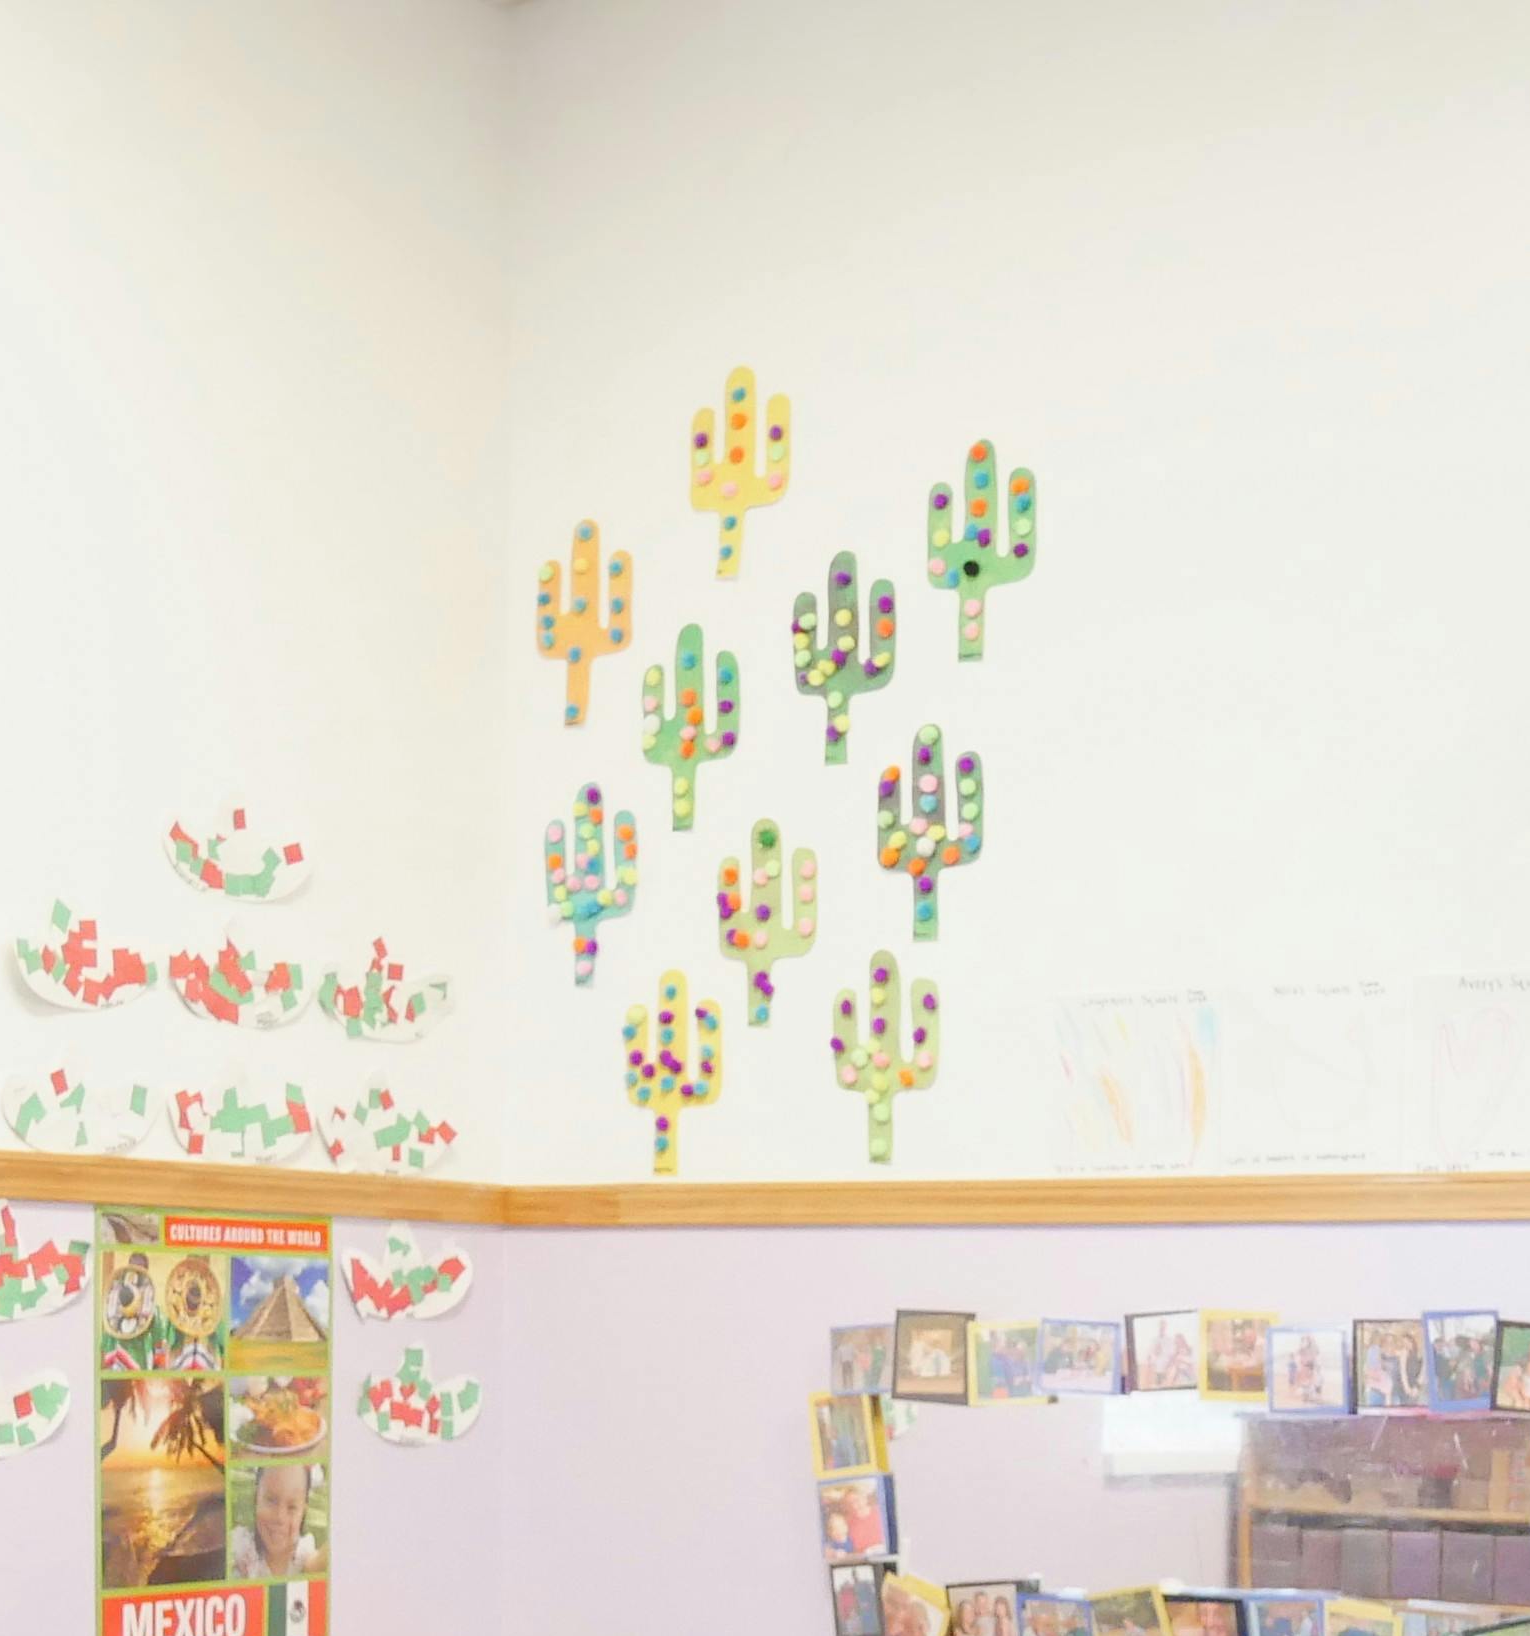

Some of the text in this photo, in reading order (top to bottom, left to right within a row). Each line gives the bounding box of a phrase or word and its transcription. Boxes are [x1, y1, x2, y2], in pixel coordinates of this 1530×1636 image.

[169, 1223, 321, 1248] CULTURES AROUND THE WORLD
